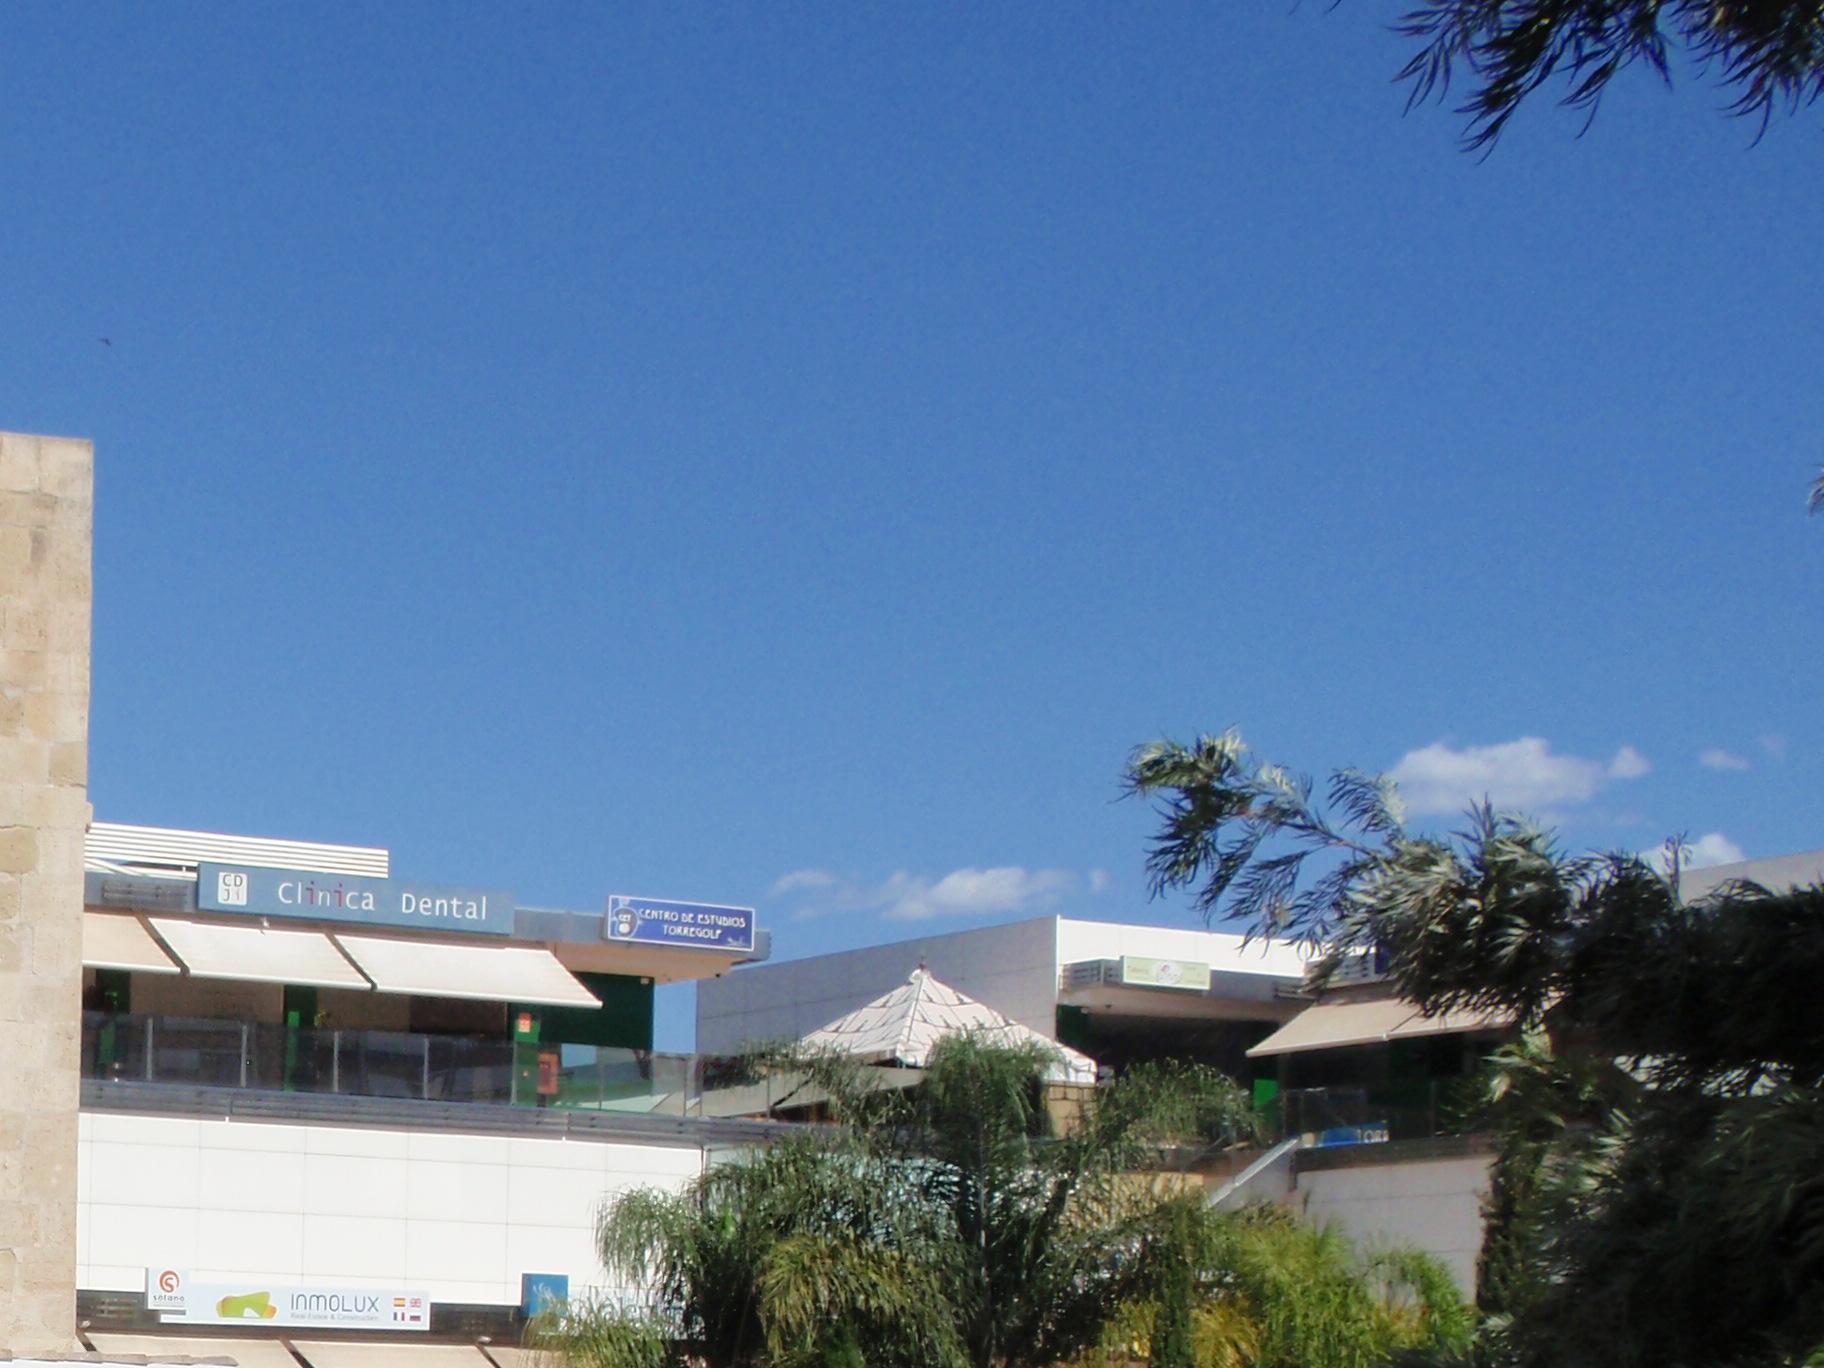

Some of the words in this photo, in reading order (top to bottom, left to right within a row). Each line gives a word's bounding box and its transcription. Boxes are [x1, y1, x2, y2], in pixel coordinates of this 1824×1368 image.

[222, 873, 243, 887] CD
[401, 892, 487, 921] Dental
[639, 908, 677, 922] CENTRO
[681, 912, 695, 924] DE
[697, 913, 746, 928] ESTUDIOS
